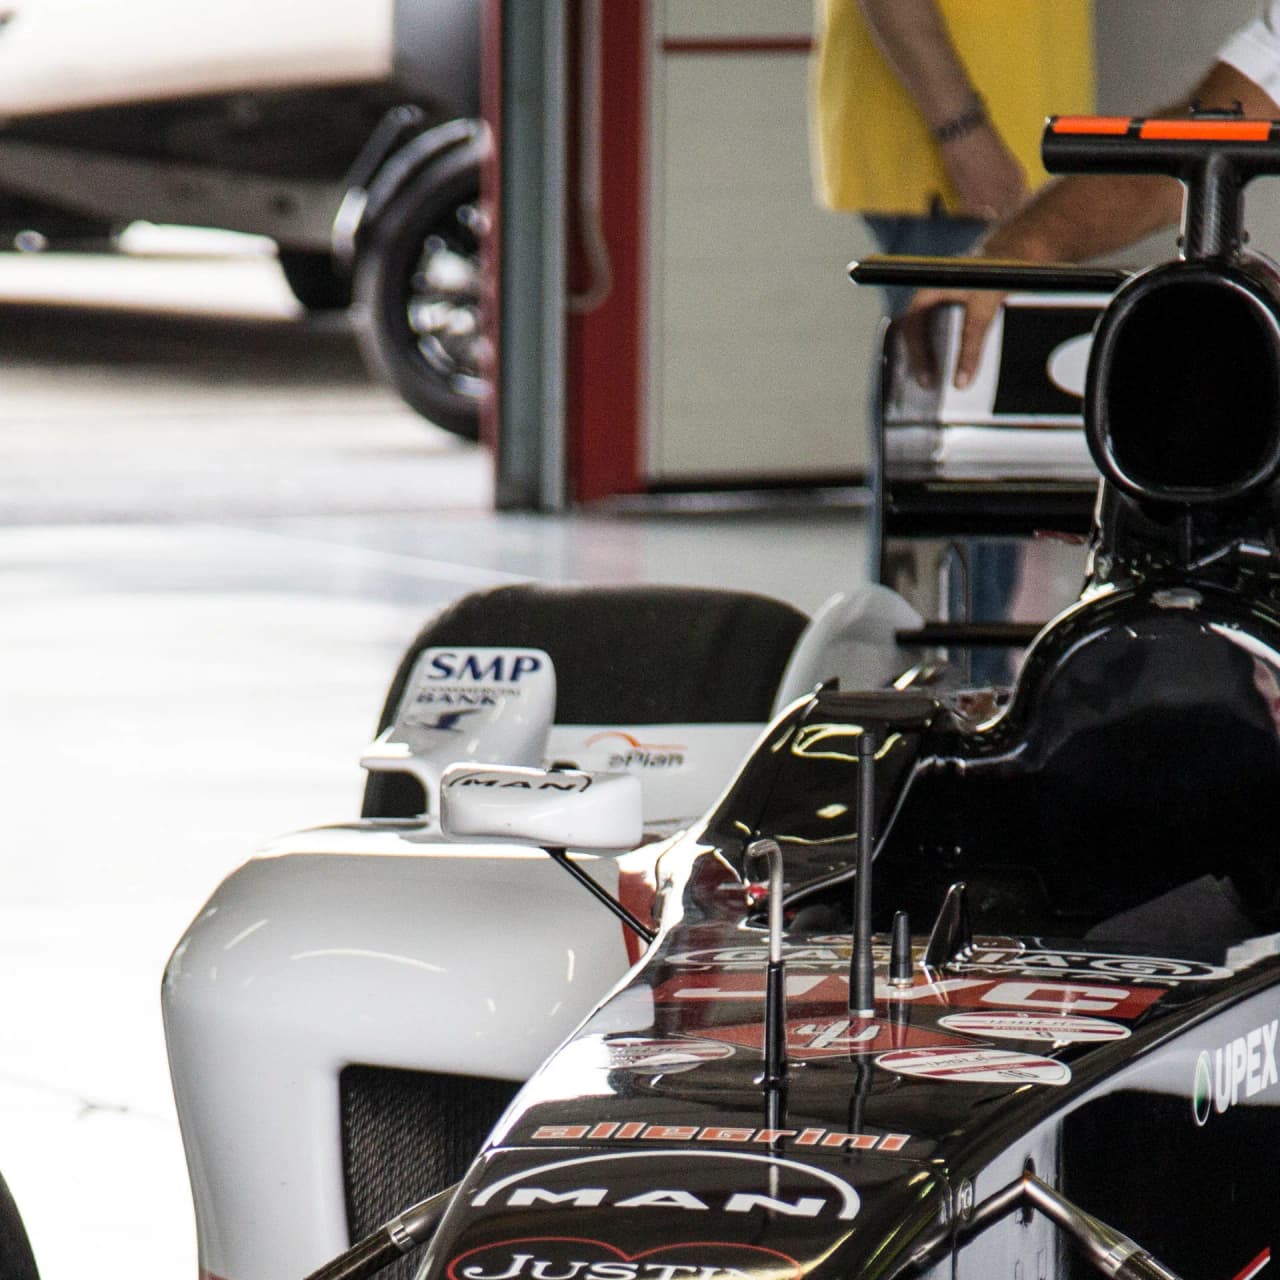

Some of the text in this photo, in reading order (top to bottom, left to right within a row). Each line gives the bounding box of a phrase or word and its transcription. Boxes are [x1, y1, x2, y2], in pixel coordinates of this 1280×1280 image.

[427, 652, 542, 683] SMP
[461, 777, 577, 790] MAN
[531, 1121, 911, 1152] allegrini
[507, 1187, 828, 1218] MAN
